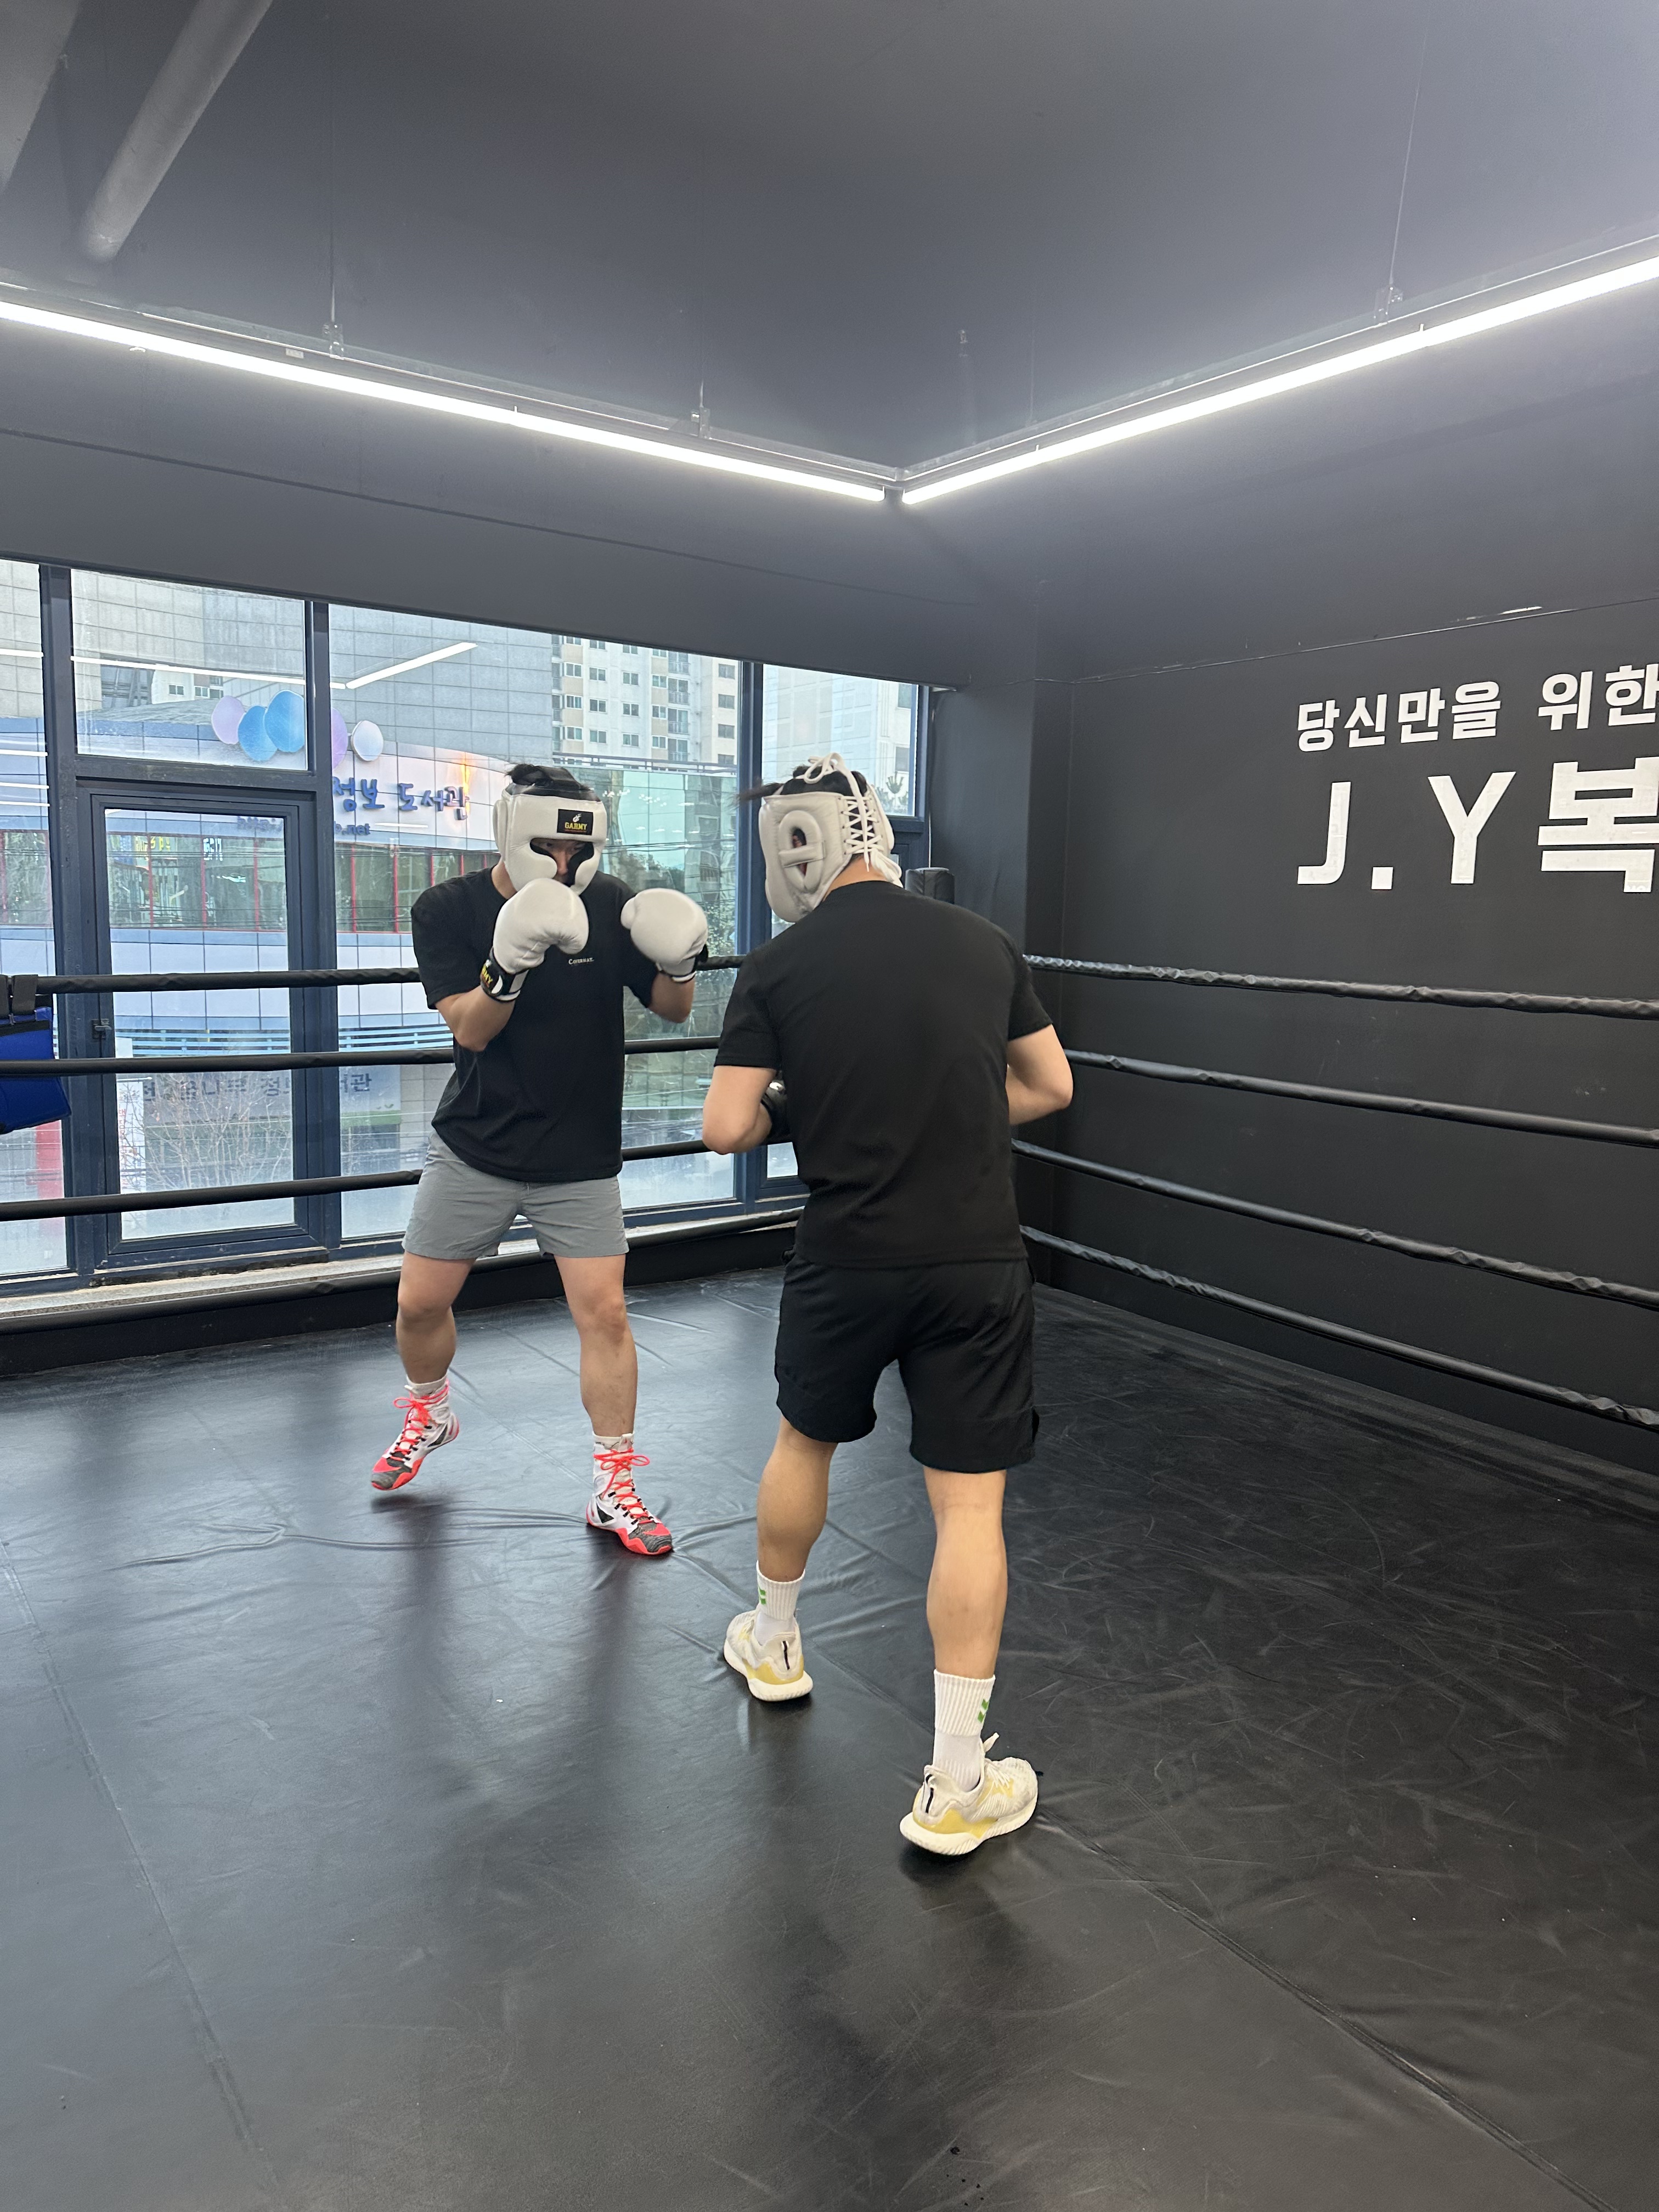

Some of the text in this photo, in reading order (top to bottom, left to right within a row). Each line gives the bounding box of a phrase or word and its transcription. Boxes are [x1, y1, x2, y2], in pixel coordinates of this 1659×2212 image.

[1297, 663, 1659, 752] 당신만을 위한
[397, 782, 470, 821] 도서관
